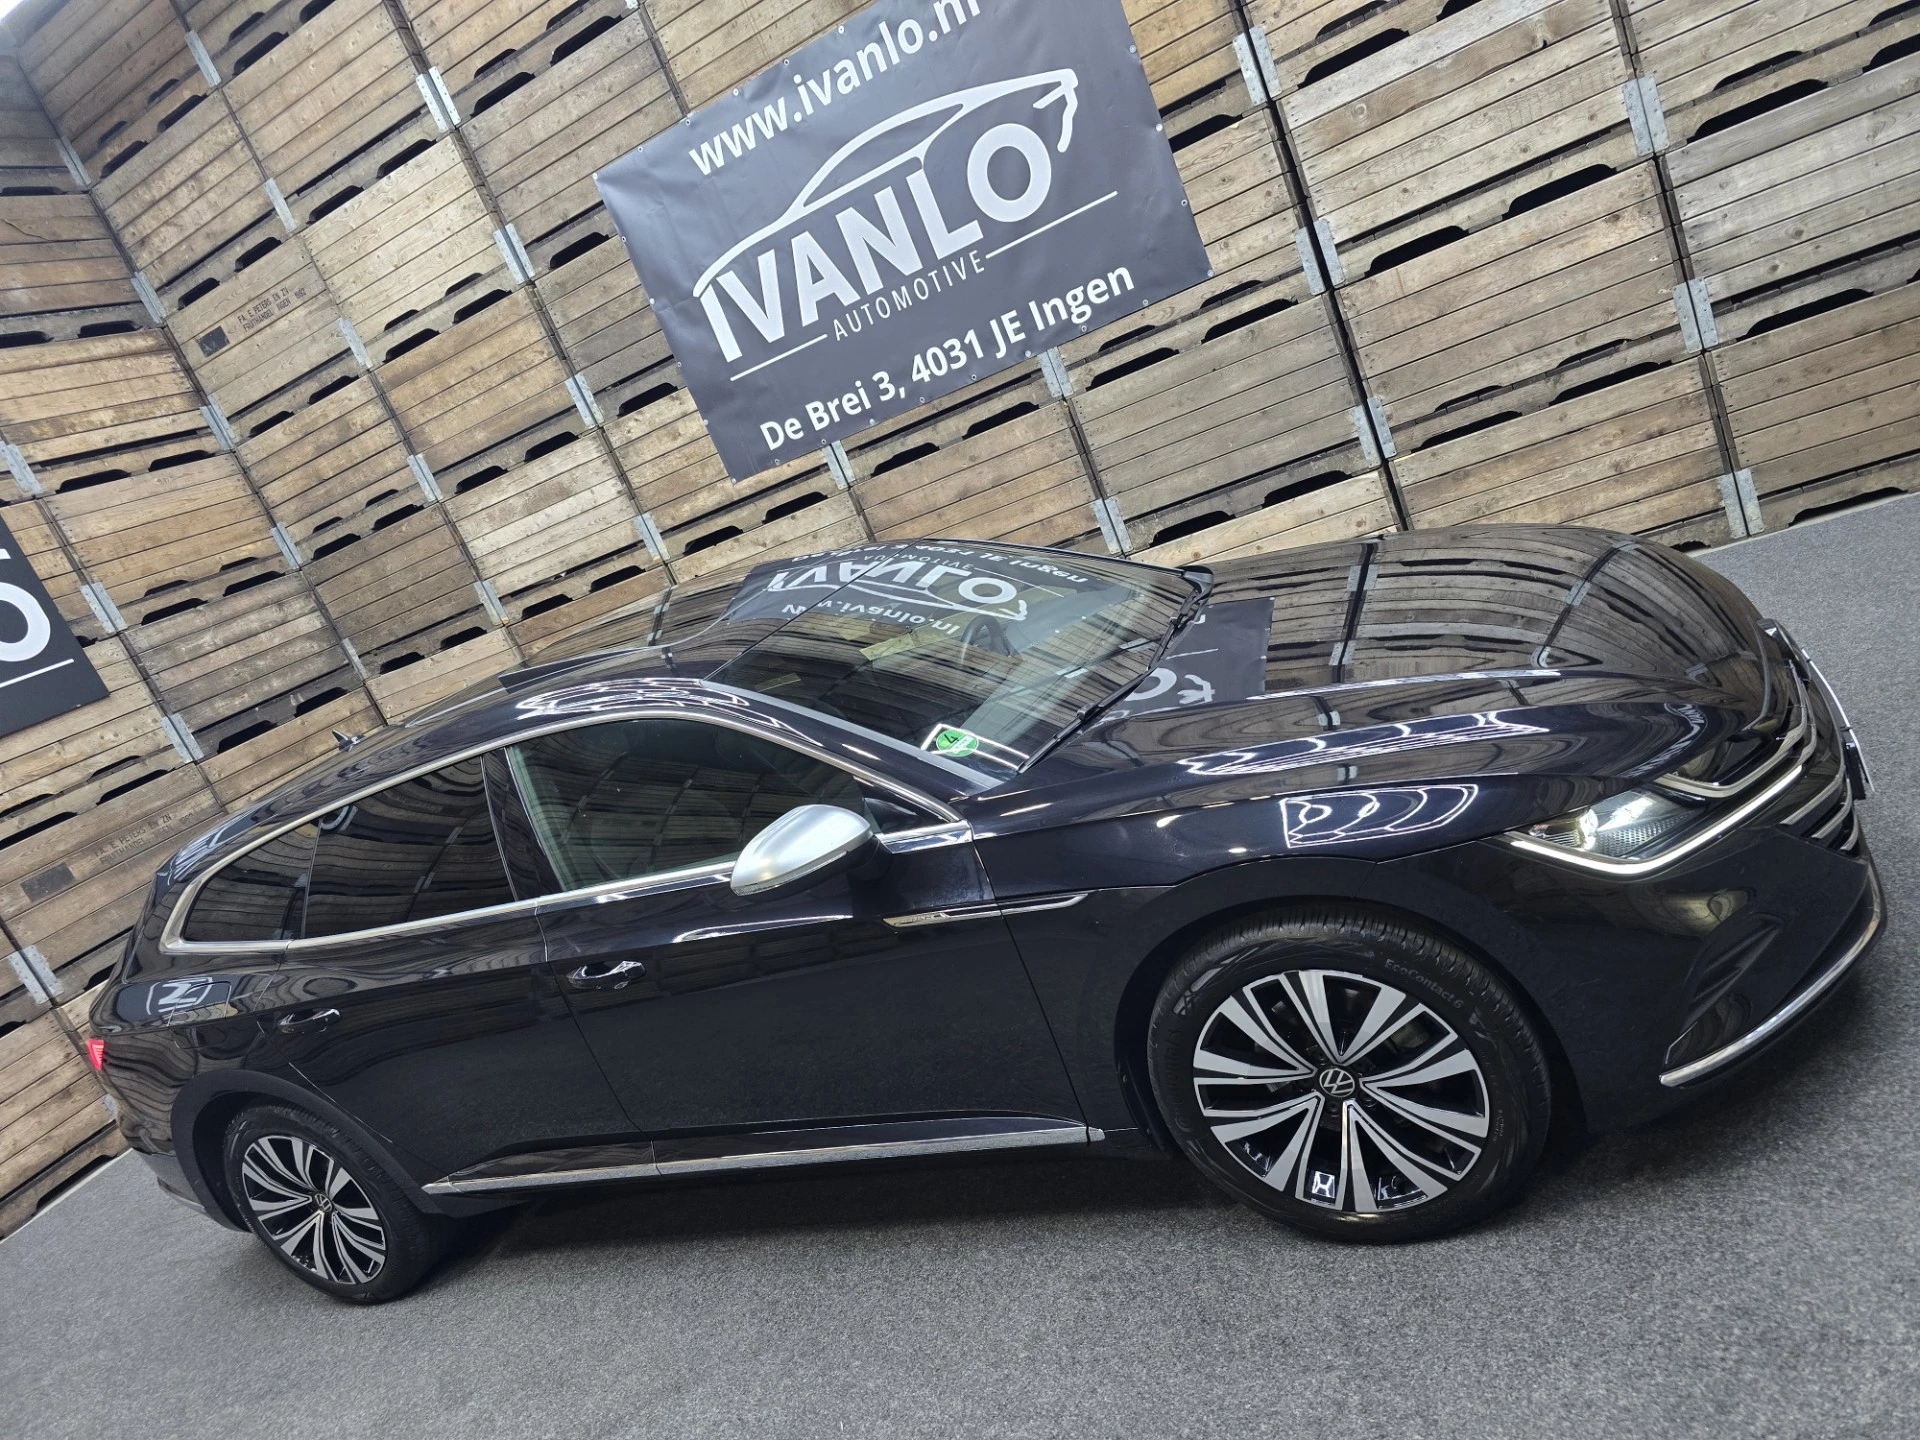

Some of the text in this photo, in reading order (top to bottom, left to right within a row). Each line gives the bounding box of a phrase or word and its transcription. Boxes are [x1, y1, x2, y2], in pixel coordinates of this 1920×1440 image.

[699, 123, 1052, 363] IVANLO
[832, 250, 985, 341] AUTOMOTIVE
[759, 266, 1135, 451] De Brei 3, 4031 JE Ingen
[161, 814, 172, 823] ZN
